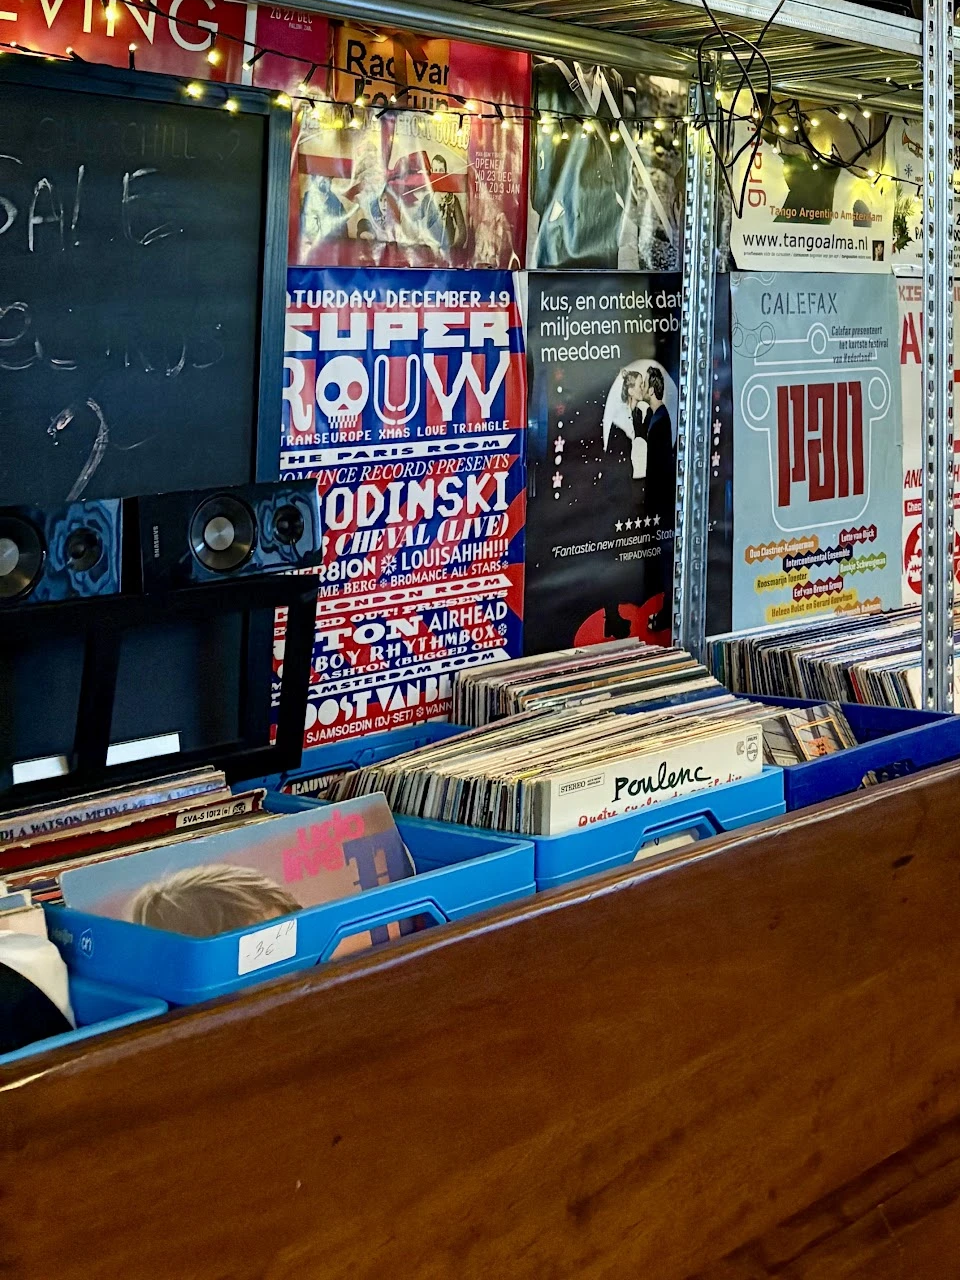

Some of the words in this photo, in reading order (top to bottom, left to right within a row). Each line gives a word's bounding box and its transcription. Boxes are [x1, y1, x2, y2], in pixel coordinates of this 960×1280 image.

[769, 206, 797, 217] Tango
[800, 207, 838, 220] Argentino
[840, 210, 882, 222] Amsterdam
[743, 233, 868, 251] www.tangoalma.nl
[386, 291, 481, 308] DECEMBER
[488, 291, 510, 308] 19
[541, 291, 572, 313] kus,
[576, 294, 596, 310] en
[599, 291, 653, 310] ontdek
[656, 290, 681, 309] dat
[761, 292, 838, 315] CALEFAX
[541, 317, 621, 340] miljoenen
[541, 342, 620, 362] meedoen
[379, 427, 410, 439] XMAS
[417, 423, 447, 437] LOVE
[452, 420, 510, 434] TRIANGLE
[337, 446, 414, 460] PARIS
[427, 440, 501, 453] ROOM
[359, 460, 434, 482] RECORDS
[433, 453, 510, 475] PRESENTS
[320, 471, 509, 531] ODINSKI
[334, 524, 431, 556] CHEVAL
[437, 512, 508, 545] (LIVE)
[596, 539, 614, 552] new
[615, 534, 650, 549] museum
[401, 538, 509, 571] LOUISAHHH!!!
[619, 547, 661, 562] TRIPADVISOR
[343, 579, 376, 595] BERG
[391, 569, 448, 588] BROMANCE
[451, 566, 468, 578] ALL
[472, 561, 501, 575] STARS
[320, 589, 423, 613] LONDON
[436, 577, 500, 594] ROOM
[351, 608, 399, 624] OUT!
[402, 590, 508, 614] PRESENTS
[428, 601, 508, 633] AIRHEAD
[370, 622, 496, 662] RHYTHMBOX
[308, 665, 431, 696] AMSTERDAM
[441, 651, 496, 668] ROOM
[318, 661, 391, 683] ASHTON
[396, 644, 468, 666] (BUGGED
[471, 637, 508, 651] OUT)
[306, 718, 373, 743] SJAMSOEDIN
[561, 780, 586, 793] STEREO
[611, 761, 711, 802] Poulenc
[183, 812, 205, 825] SVA-S
[297, 809, 365, 850] udo
[283, 844, 344, 885] live
